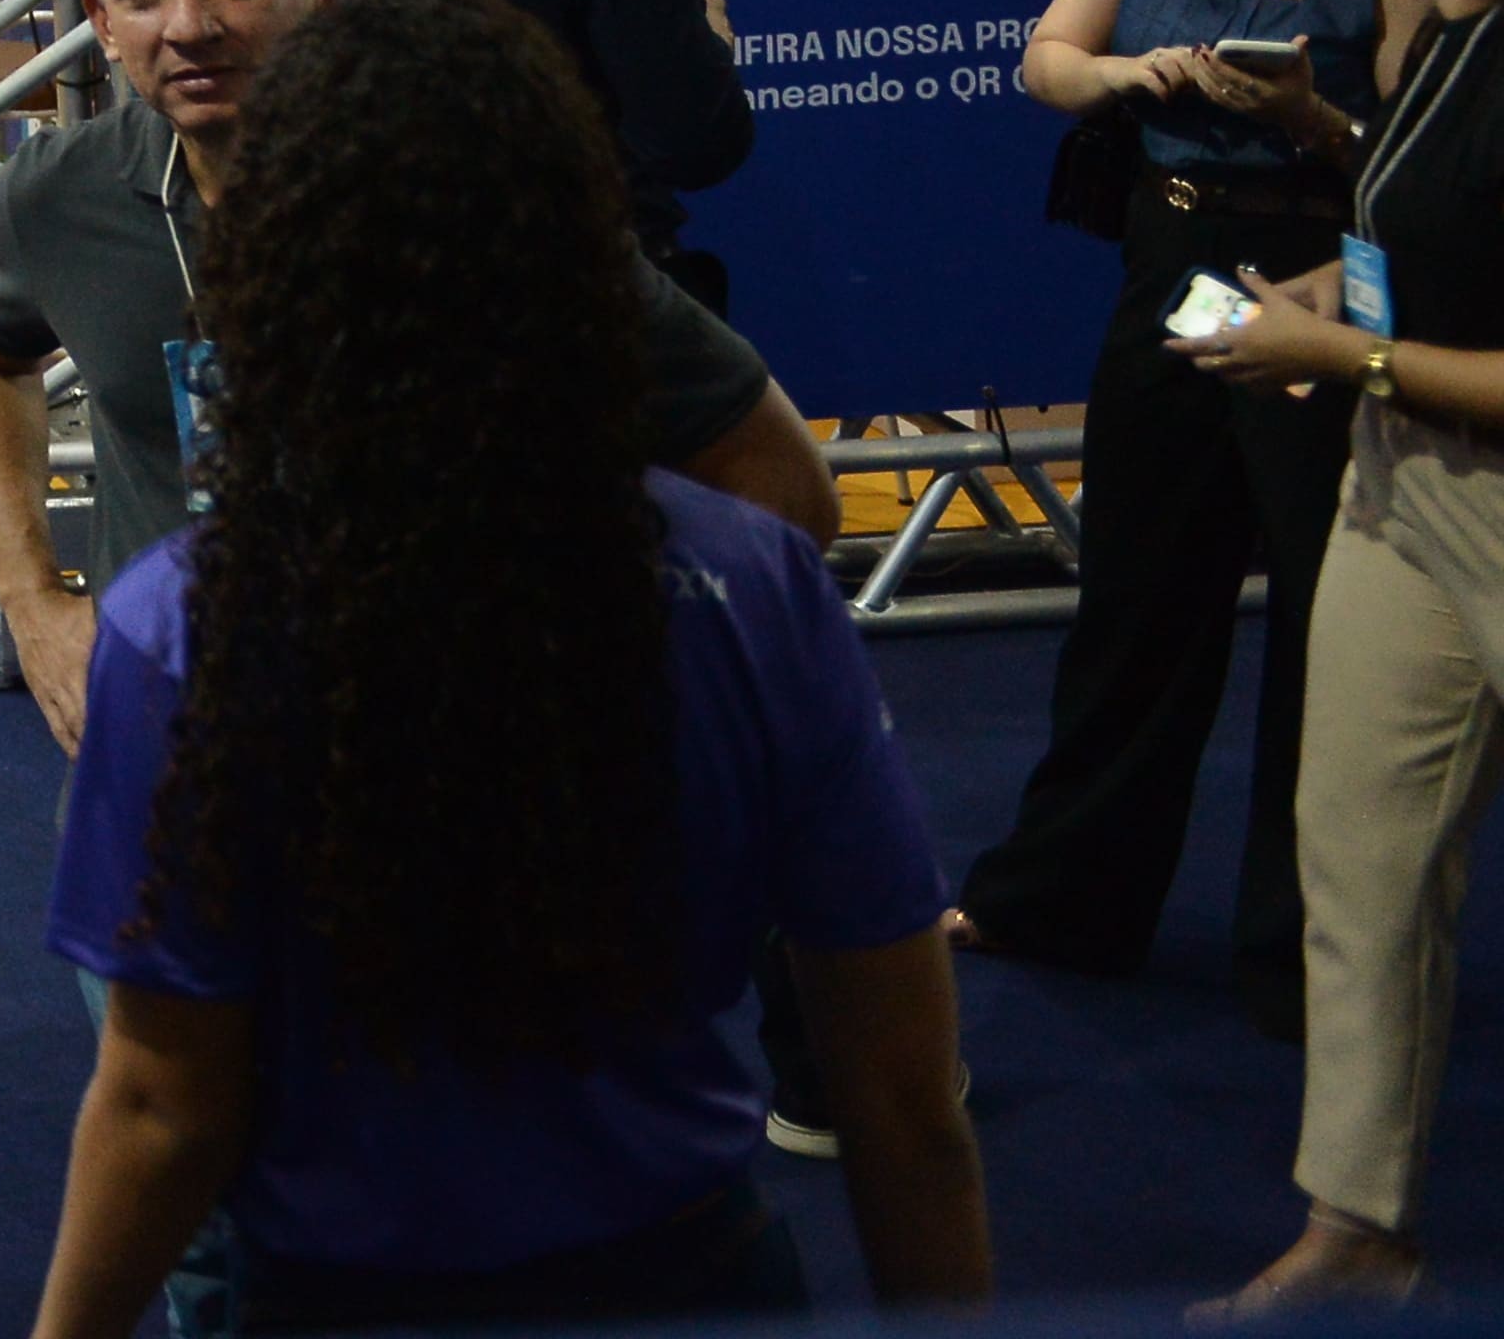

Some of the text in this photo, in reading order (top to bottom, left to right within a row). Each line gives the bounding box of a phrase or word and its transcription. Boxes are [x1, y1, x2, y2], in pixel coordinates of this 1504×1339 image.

[836, 21, 965, 60] NOSSA
[915, 76, 939, 100] o
[950, 65, 1001, 103] QR
